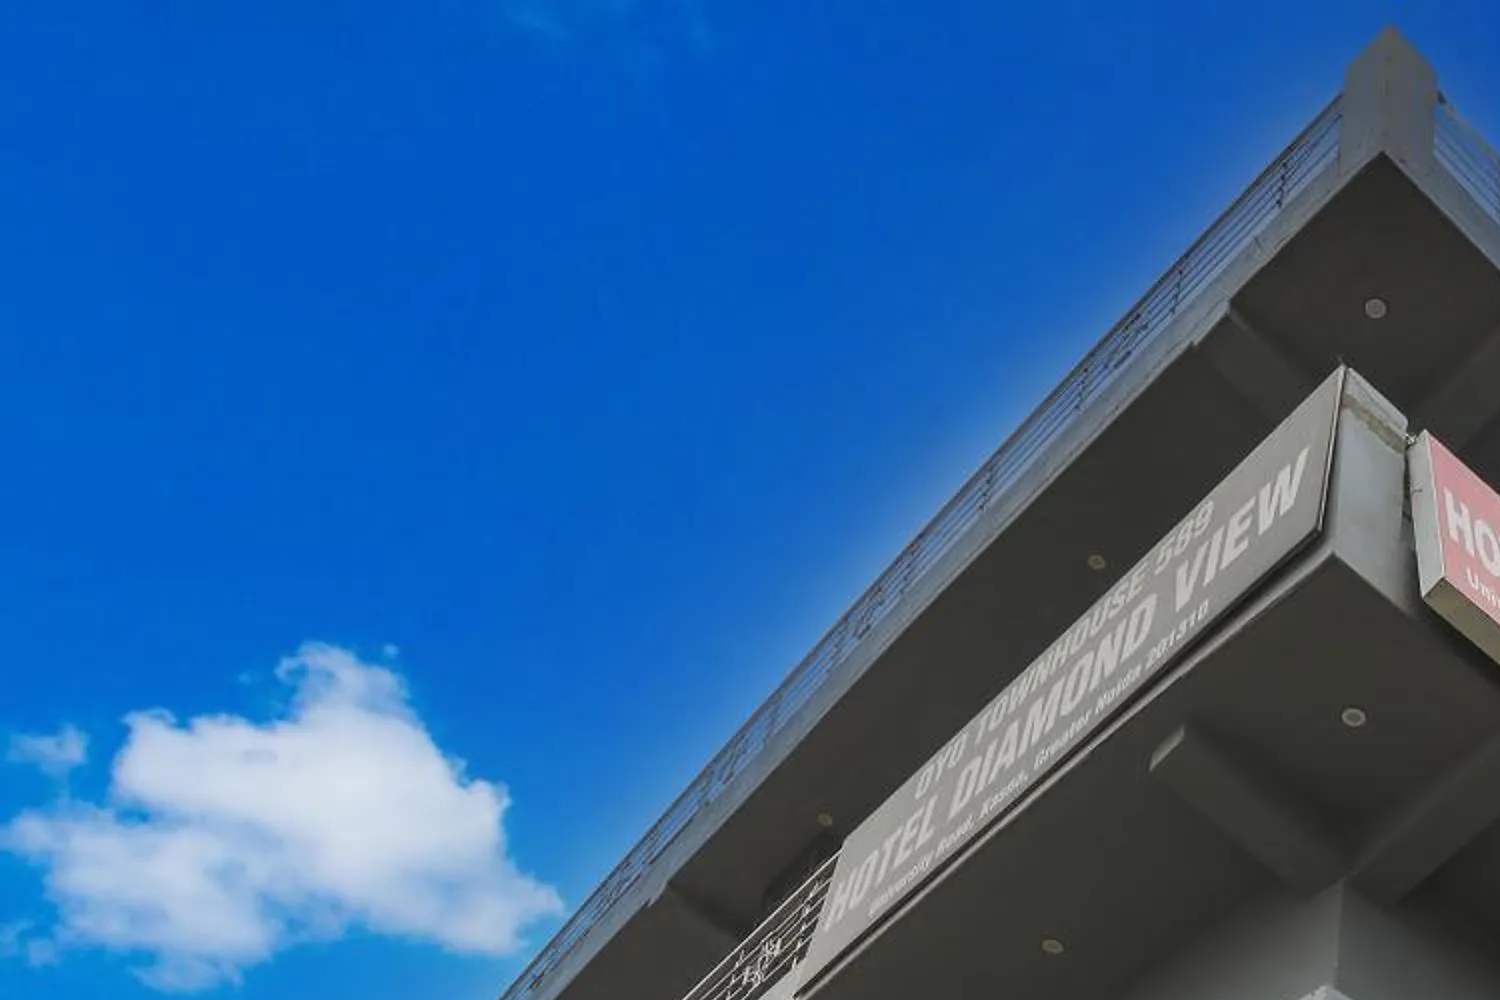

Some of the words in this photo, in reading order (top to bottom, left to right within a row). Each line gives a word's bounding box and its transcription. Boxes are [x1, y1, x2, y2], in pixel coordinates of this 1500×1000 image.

[824, 796, 938, 932] HOTEL
[948, 593, 1157, 823] DIAMOND
[1175, 447, 1310, 613] VIEW
[914, 731, 968, 800] OYO
[975, 561, 1149, 745] TOWNHOUSE
[1154, 500, 1214, 576] 589
